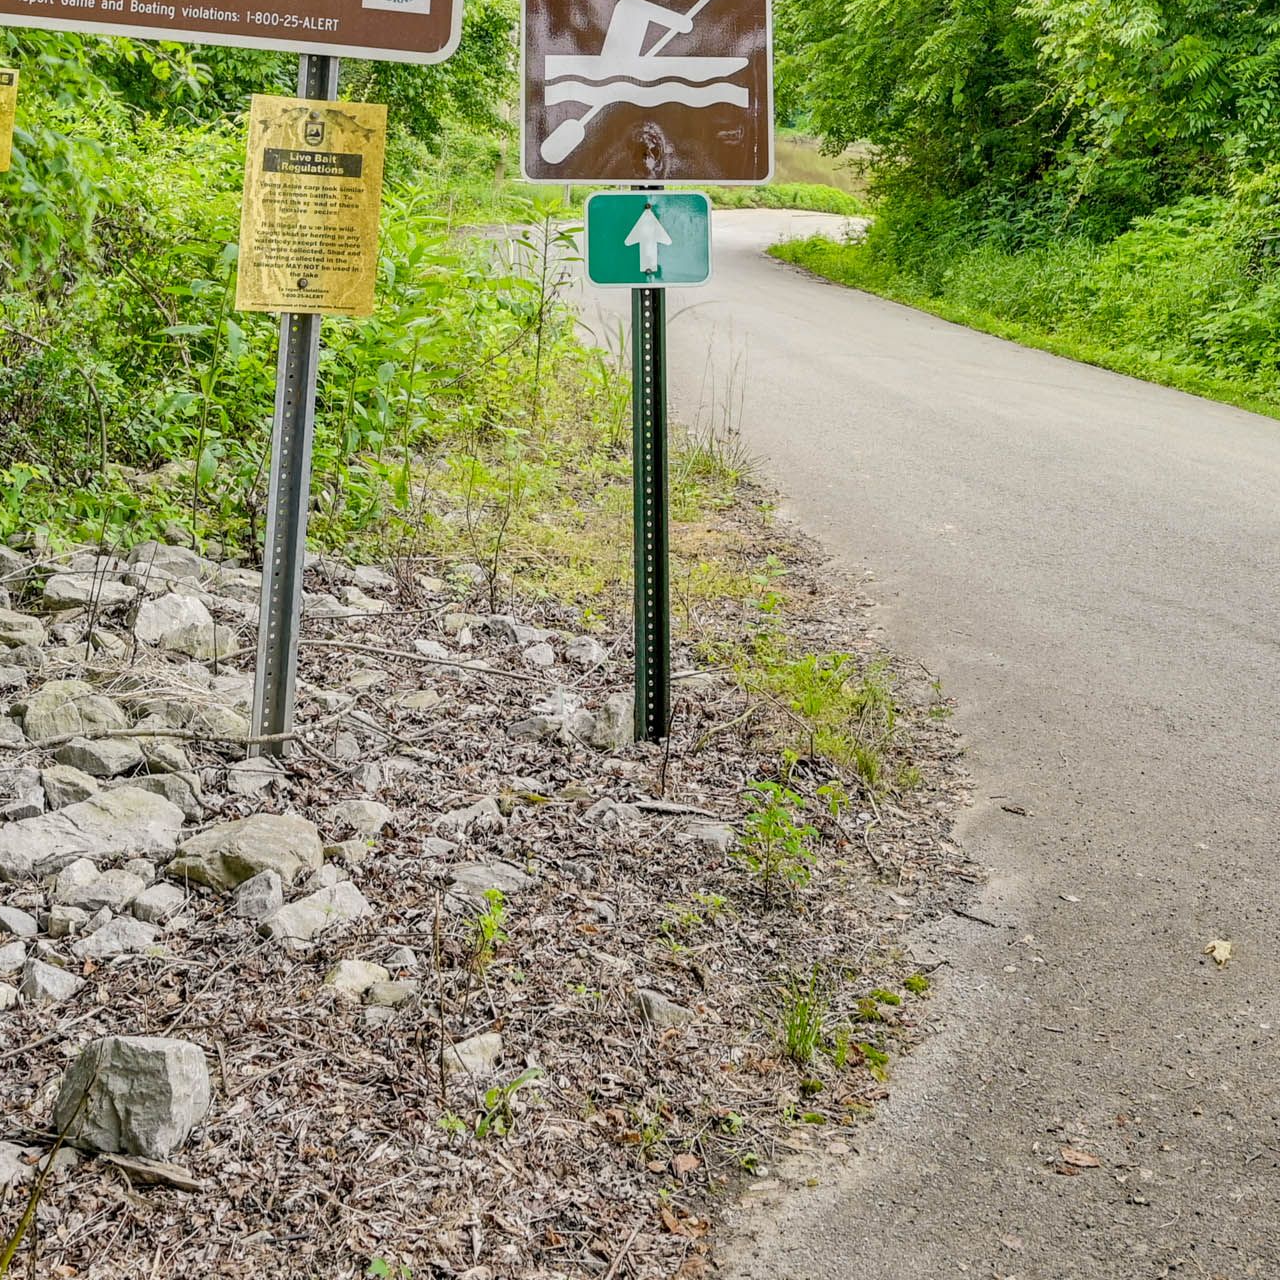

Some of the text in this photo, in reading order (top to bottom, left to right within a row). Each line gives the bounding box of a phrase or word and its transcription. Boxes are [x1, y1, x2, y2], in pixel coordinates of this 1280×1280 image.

[130, 0, 176, 20] Boating
[181, 5, 240, 22] violations:
[246, 10, 339, 31] 1-800-25-ALERT
[290, 152, 337, 163] Live Bait
[281, 162, 344, 175] Regulations
[310, 232, 336, 240] herring
[291, 255, 325, 263] collected
